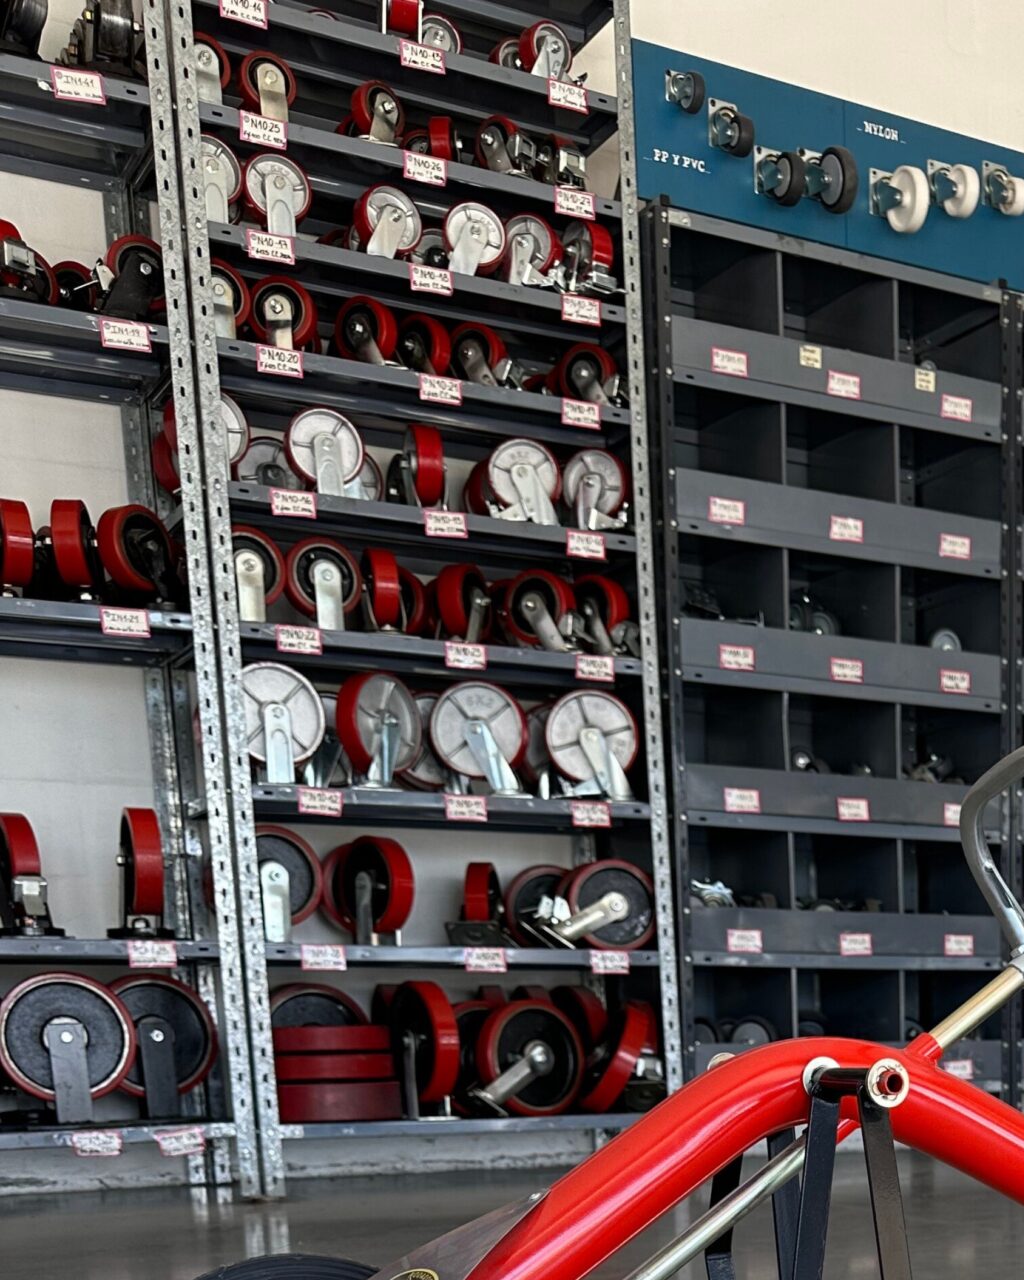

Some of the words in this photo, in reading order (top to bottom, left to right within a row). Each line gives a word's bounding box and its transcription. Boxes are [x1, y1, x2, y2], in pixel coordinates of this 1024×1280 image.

[863, 121, 899, 142] NYLON
[653, 148, 669, 163] PP
[672, 153, 680, 166] Y
[682, 155, 706, 173] PVC
